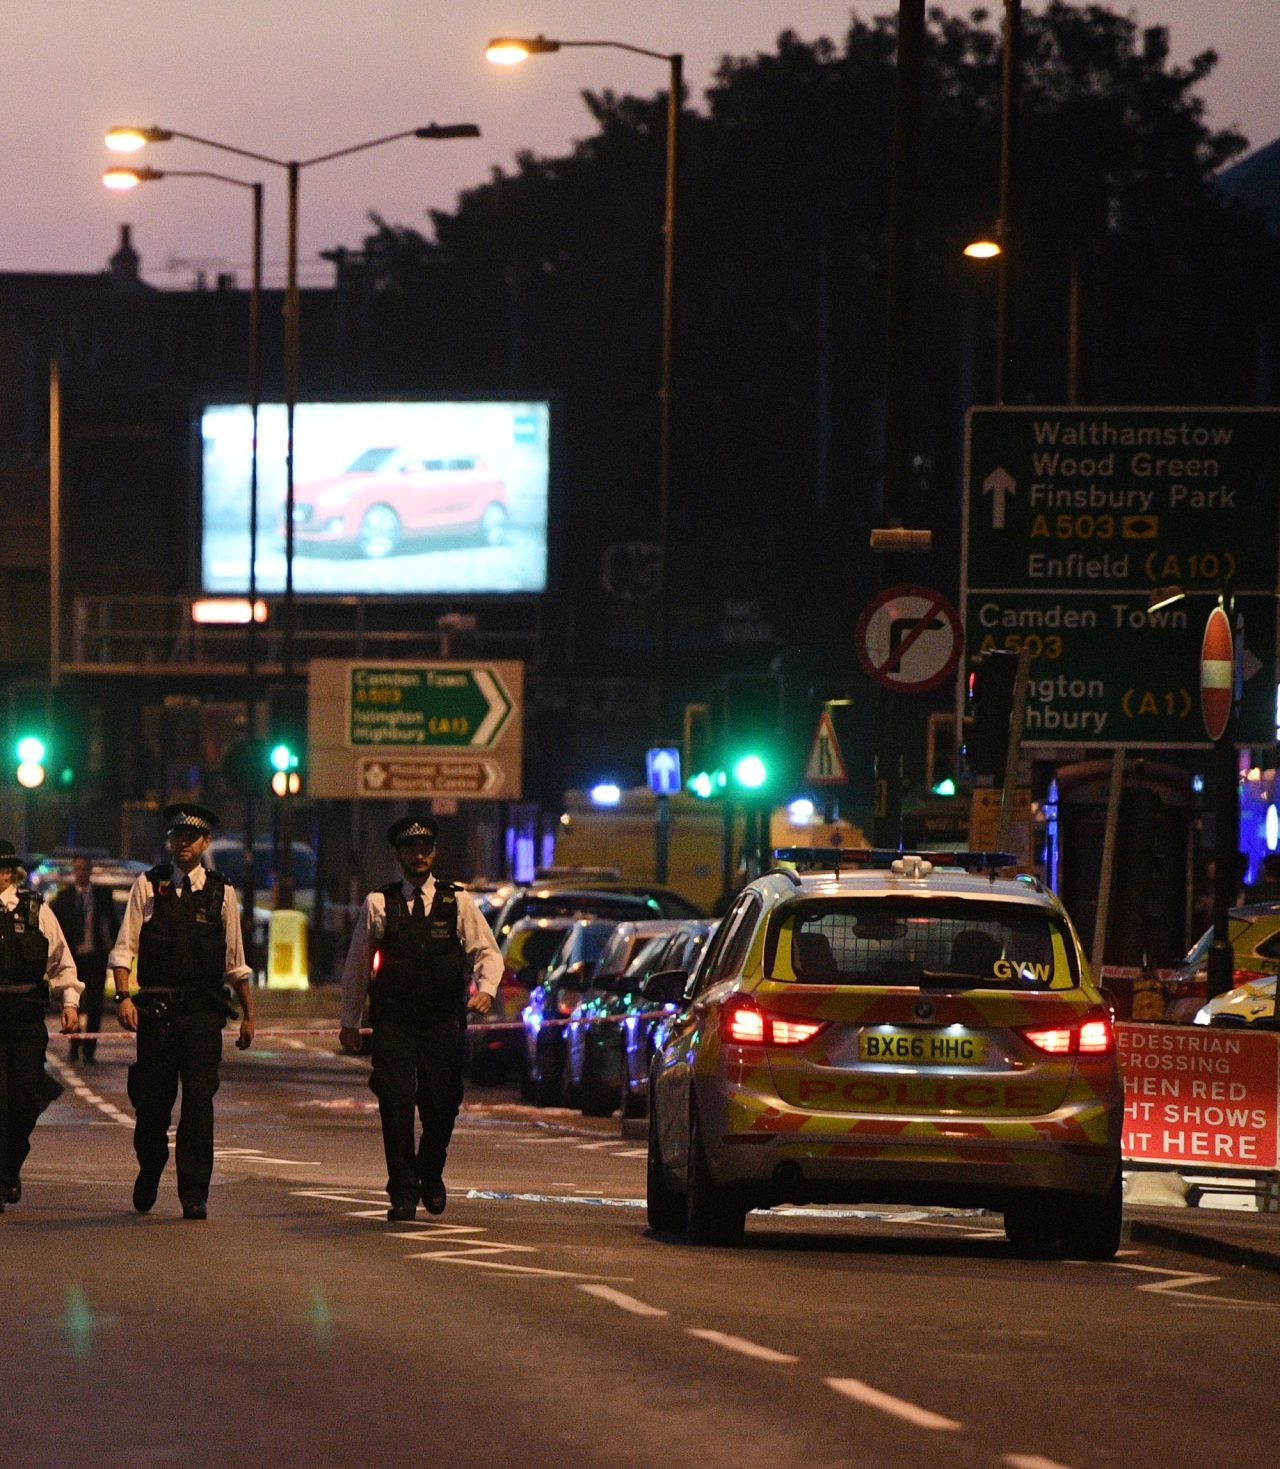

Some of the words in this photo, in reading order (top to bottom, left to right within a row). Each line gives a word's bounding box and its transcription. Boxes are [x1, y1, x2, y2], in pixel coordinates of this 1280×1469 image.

[1033, 421, 1233, 446] Walthamstow
[1032, 452, 1115, 477] Wood
[1130, 452, 1220, 477] Green
[1030, 484, 1154, 512] Finsbury
[1171, 484, 1236, 508] Park
[1028, 553, 1129, 578] Enfield
[1144, 551, 1237, 581] (A10)
[979, 604, 1096, 628] Camden
[1112, 604, 1188, 628] Town
[355, 672, 420, 687] Camden
[427, 671, 469, 687] Town
[1027, 674, 1104, 702] ngton
[1122, 688, 1193, 719] (A1)
[354, 710, 424, 729] Islington
[1026, 706, 1107, 733] hbury
[354, 728, 425, 744] Highbury
[993, 960, 1050, 982] GYW
[867, 1037, 924, 1057] BX66
[930, 1039, 974, 1058] HHG
[1118, 1032, 1241, 1054] EDESTRIAN
[799, 1079, 1041, 1108] POLICE
[1123, 1076, 1180, 1097] HEN
[1192, 1080, 1247, 1101] RED
[1164, 1104, 1267, 1129] SHOWS
[1163, 1130, 1258, 1160] HERE
